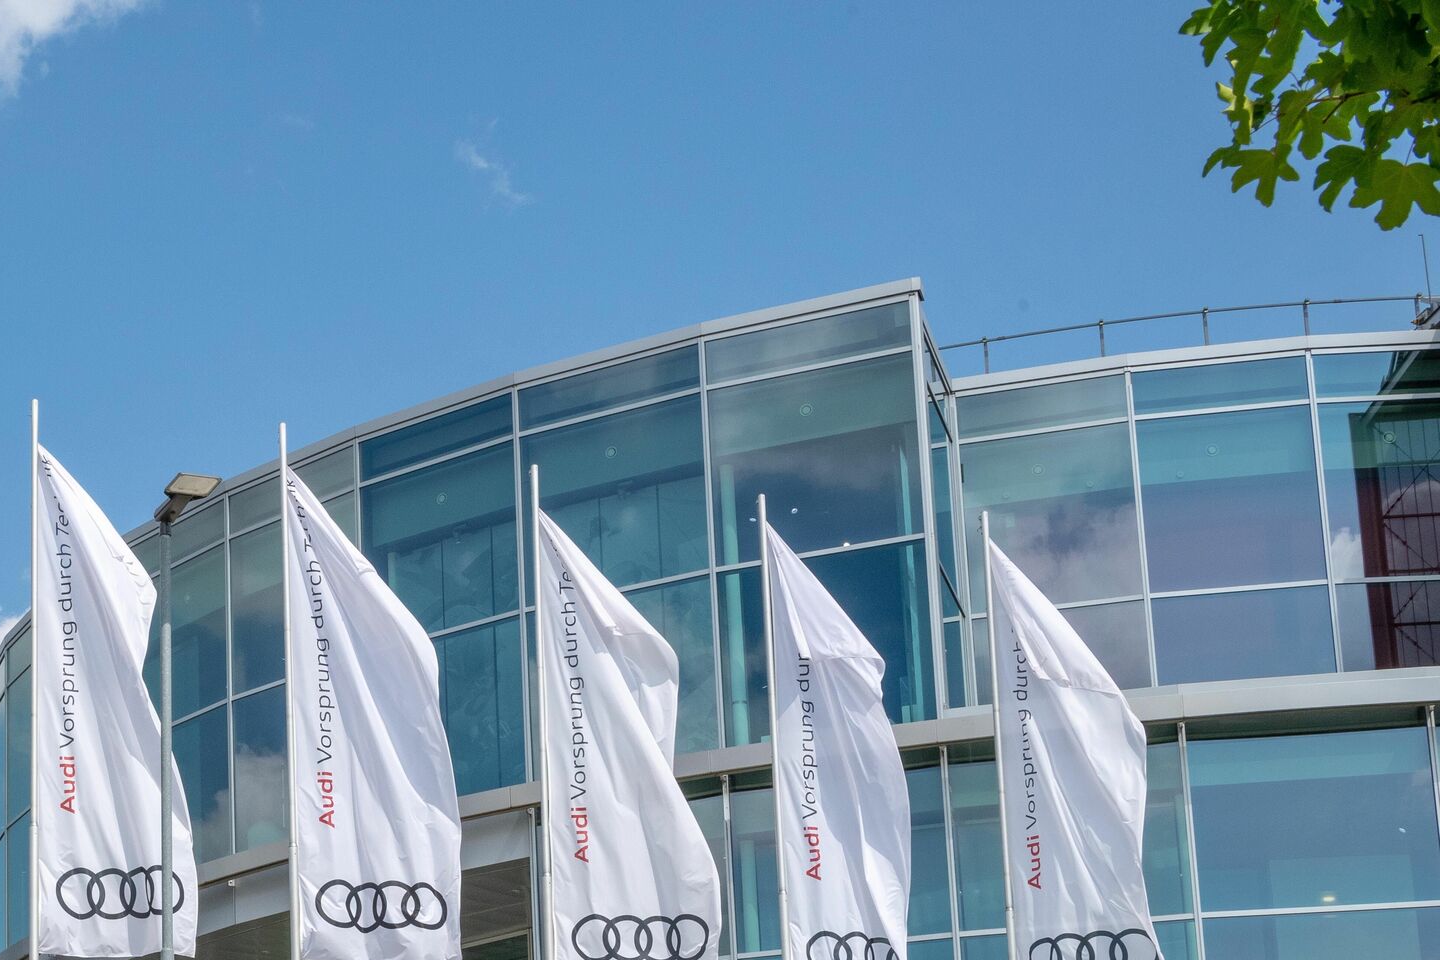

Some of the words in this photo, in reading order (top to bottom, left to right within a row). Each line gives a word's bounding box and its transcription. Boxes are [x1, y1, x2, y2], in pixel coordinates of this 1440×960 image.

[56, 543, 73, 612] durch
[306, 560, 325, 629] durch
[561, 601, 579, 668] durch
[59, 621, 79, 748] Vorsprung
[316, 638, 335, 764] Vorsprung
[797, 652, 810, 692] dur
[568, 676, 589, 800] Vorsprung
[801, 700, 818, 820] Vorsprung
[1018, 709, 1037, 830] Vorsprung
[59, 755, 77, 814] Audi
[317, 771, 336, 829] Audi
[571, 807, 589, 863] Audi
[803, 826, 822, 881] Audi
[1026, 834, 1042, 890] Audi
